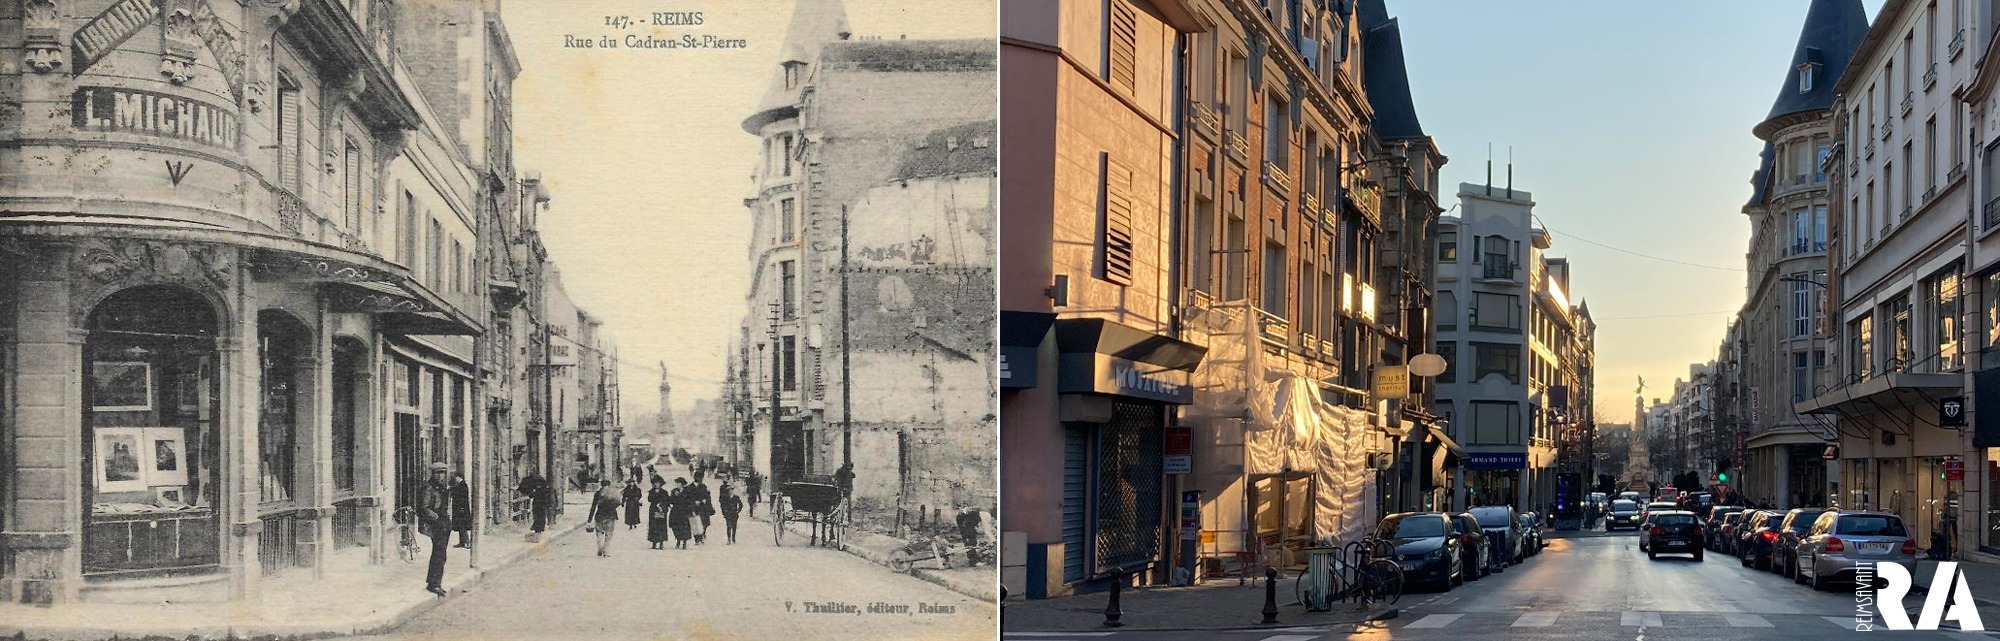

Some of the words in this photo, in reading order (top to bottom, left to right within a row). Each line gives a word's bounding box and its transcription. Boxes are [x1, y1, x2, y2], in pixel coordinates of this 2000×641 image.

[86, 91, 110, 127] L.
[113, 92, 235, 148] MICHAUD
[1115, 366, 1180, 396] MOSAIQUE
[1378, 374, 1405, 382] must
